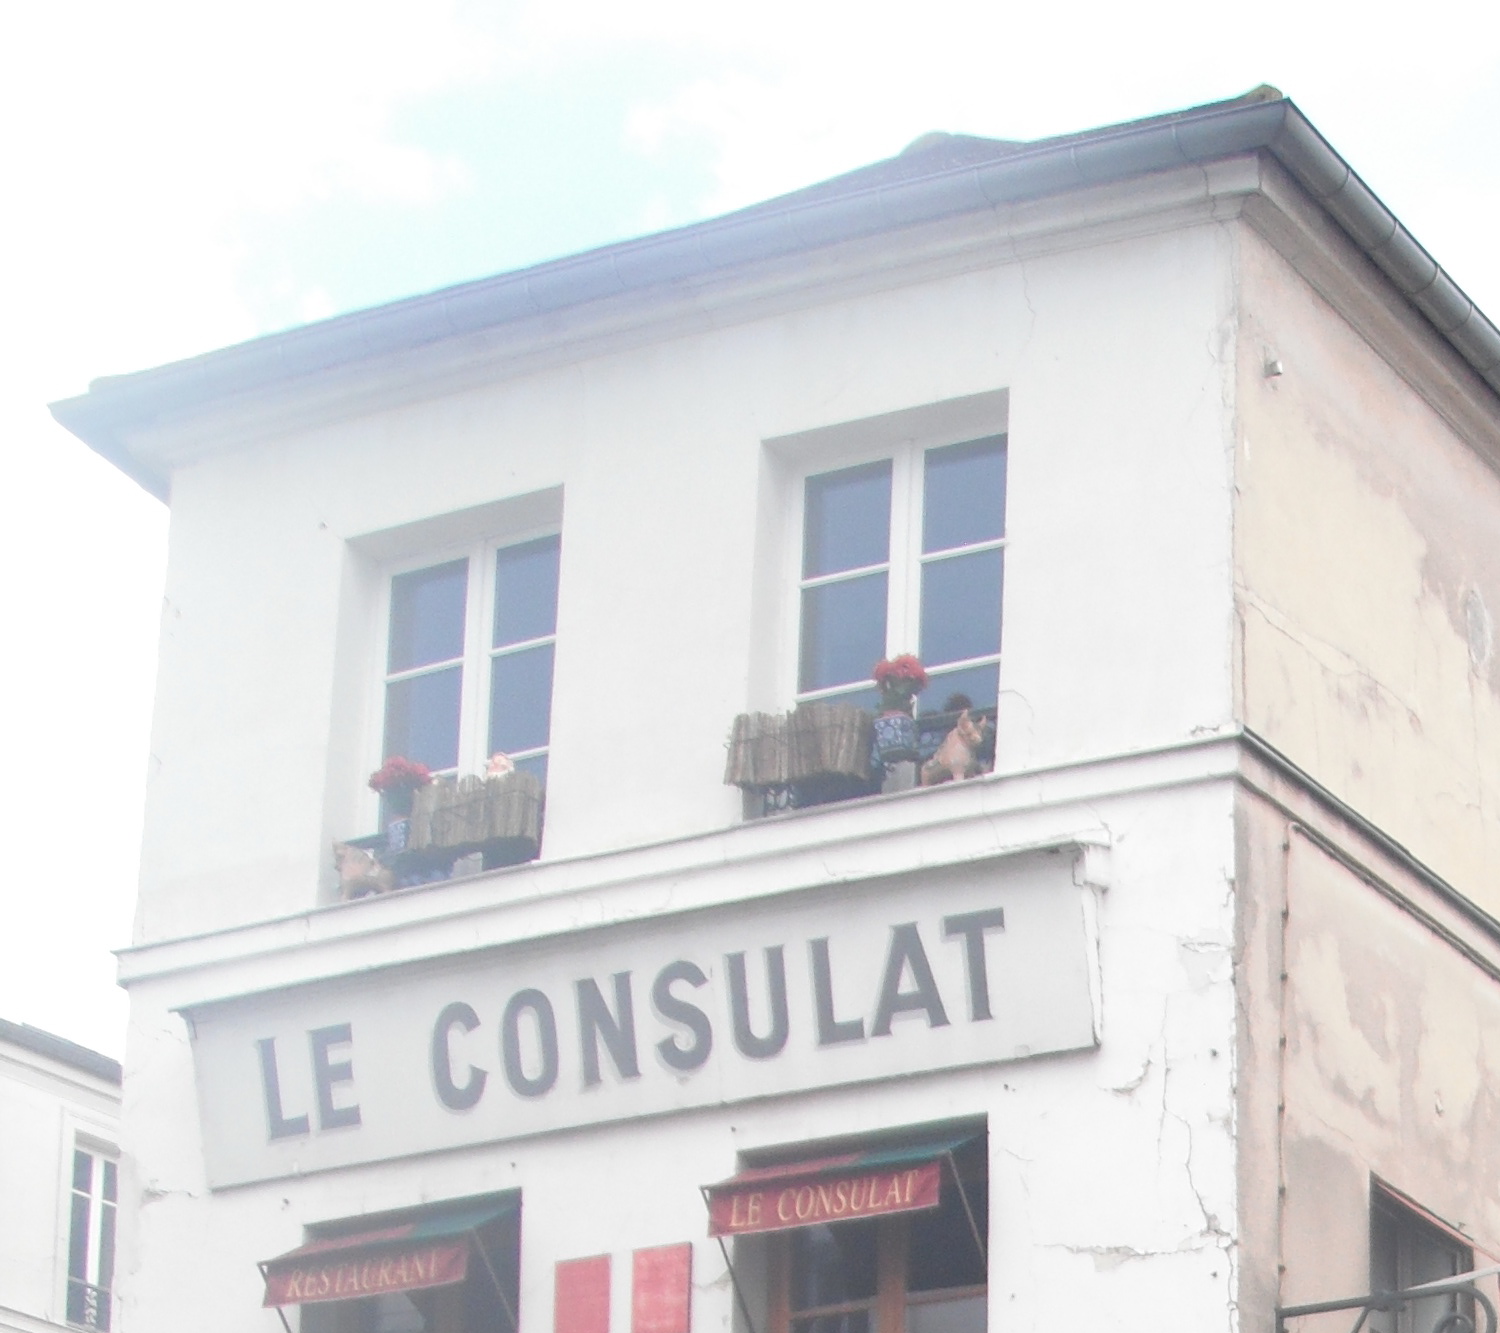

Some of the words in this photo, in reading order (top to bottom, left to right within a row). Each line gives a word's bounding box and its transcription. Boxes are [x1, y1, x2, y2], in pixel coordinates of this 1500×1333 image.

[257, 1022, 362, 1141] LE
[429, 907, 1006, 1112] CONSULAT
[728, 1191, 766, 1230] LE
[776, 1169, 920, 1224] CONSULAT
[285, 1248, 441, 1301] RESTAURANT
